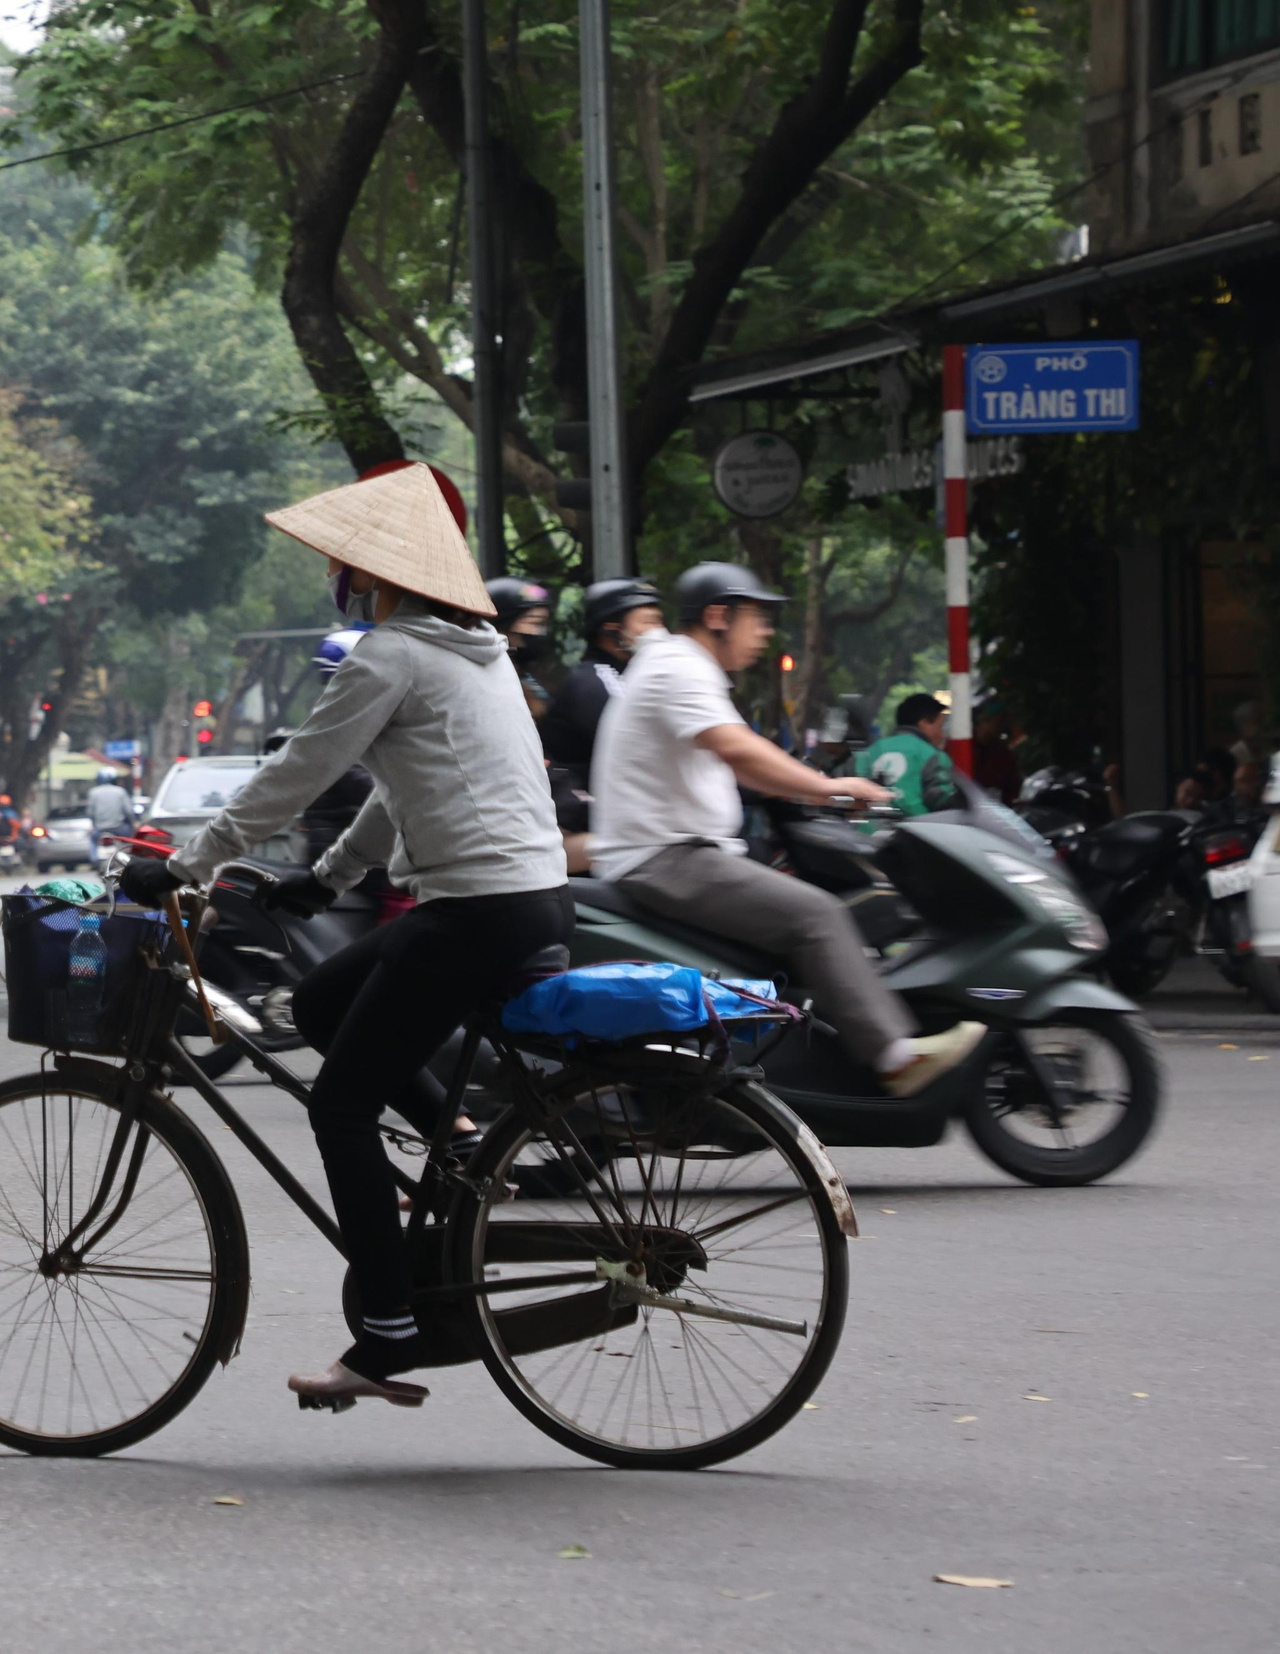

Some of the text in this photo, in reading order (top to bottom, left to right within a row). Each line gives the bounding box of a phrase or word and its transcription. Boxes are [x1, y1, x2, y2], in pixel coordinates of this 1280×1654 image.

[1035, 349, 1088, 371] PHỐ
[982, 383, 1126, 420] TRÀNG THI
